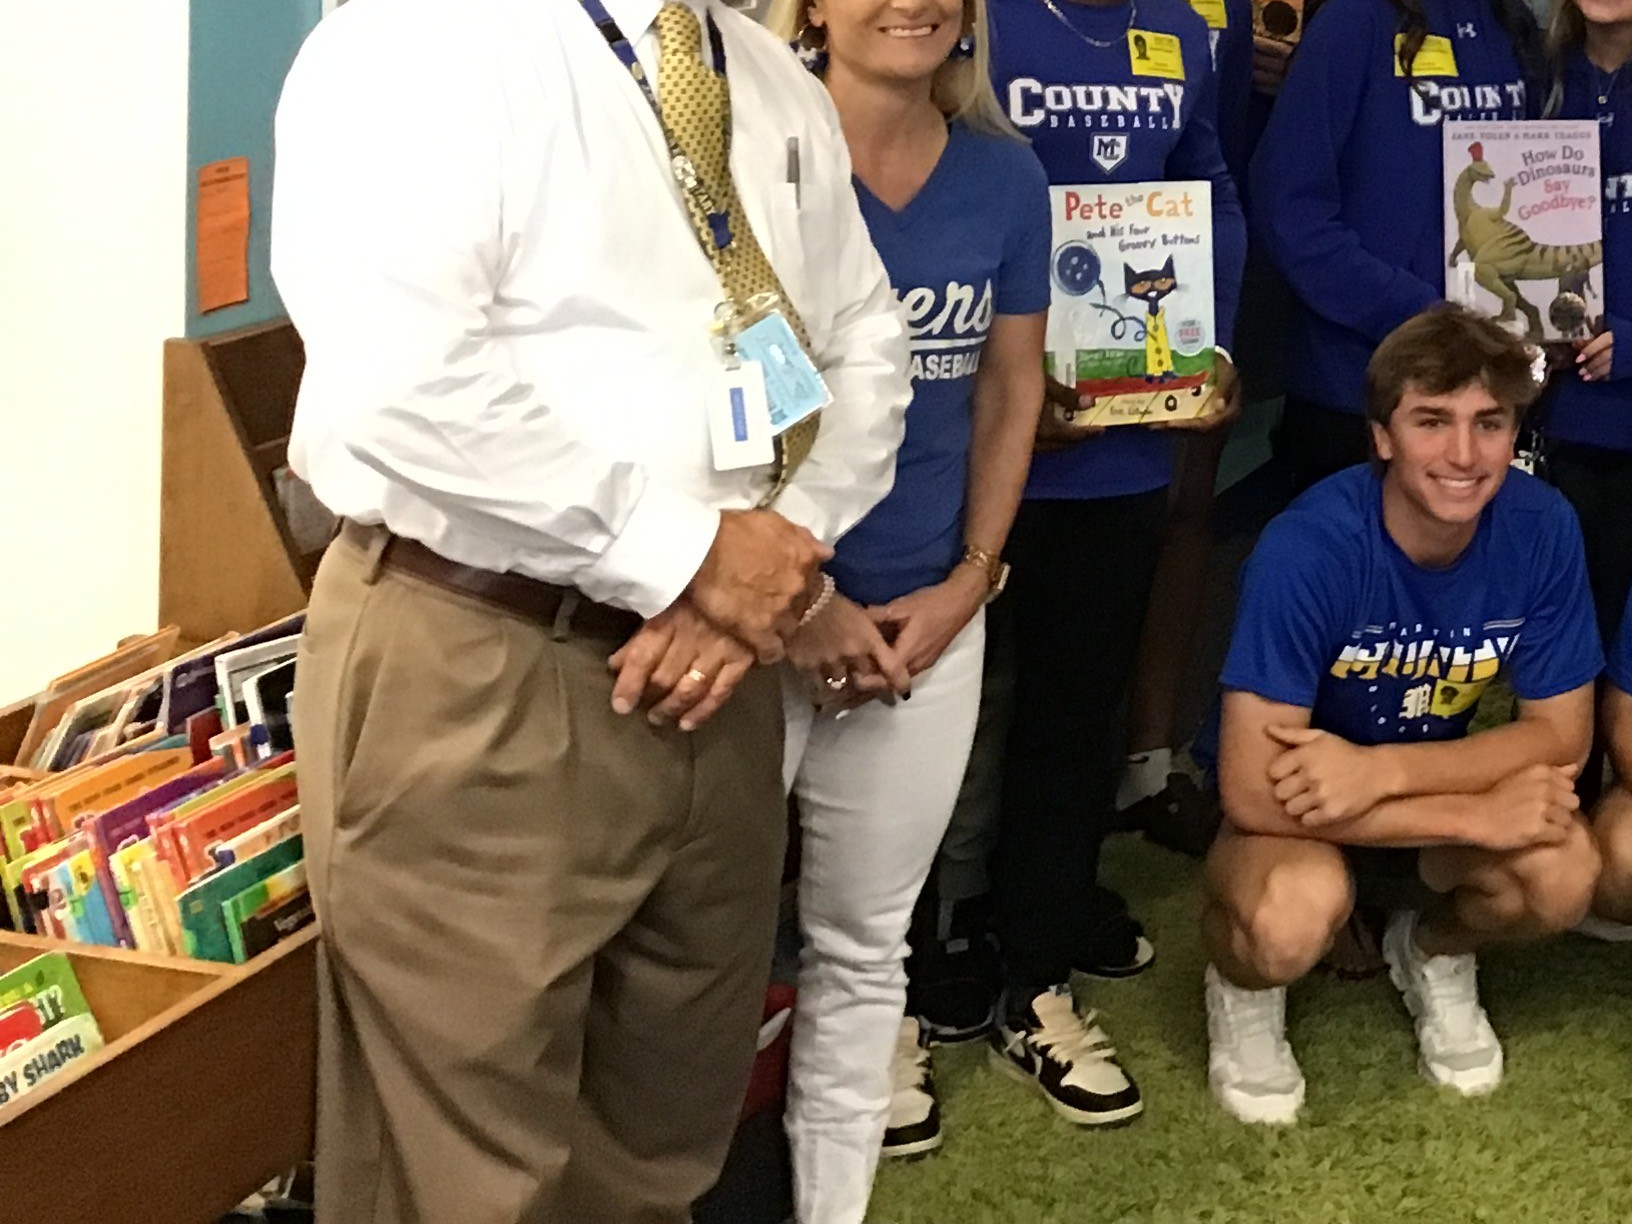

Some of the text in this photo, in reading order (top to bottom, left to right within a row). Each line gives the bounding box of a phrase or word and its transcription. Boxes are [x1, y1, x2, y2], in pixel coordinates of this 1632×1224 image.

[1410, 80, 1525, 125] COUNT
[1051, 115, 1168, 129] BASEBALL
[1522, 145, 1584, 167] How Do
[1517, 163, 1596, 186] Dinosaurs
[1544, 179, 1570, 194] Say
[1065, 191, 1193, 221] Pete the Cat
[1518, 195, 1596, 221] Goodbye?
[0, 1033, 85, 1105] BY SHARK
